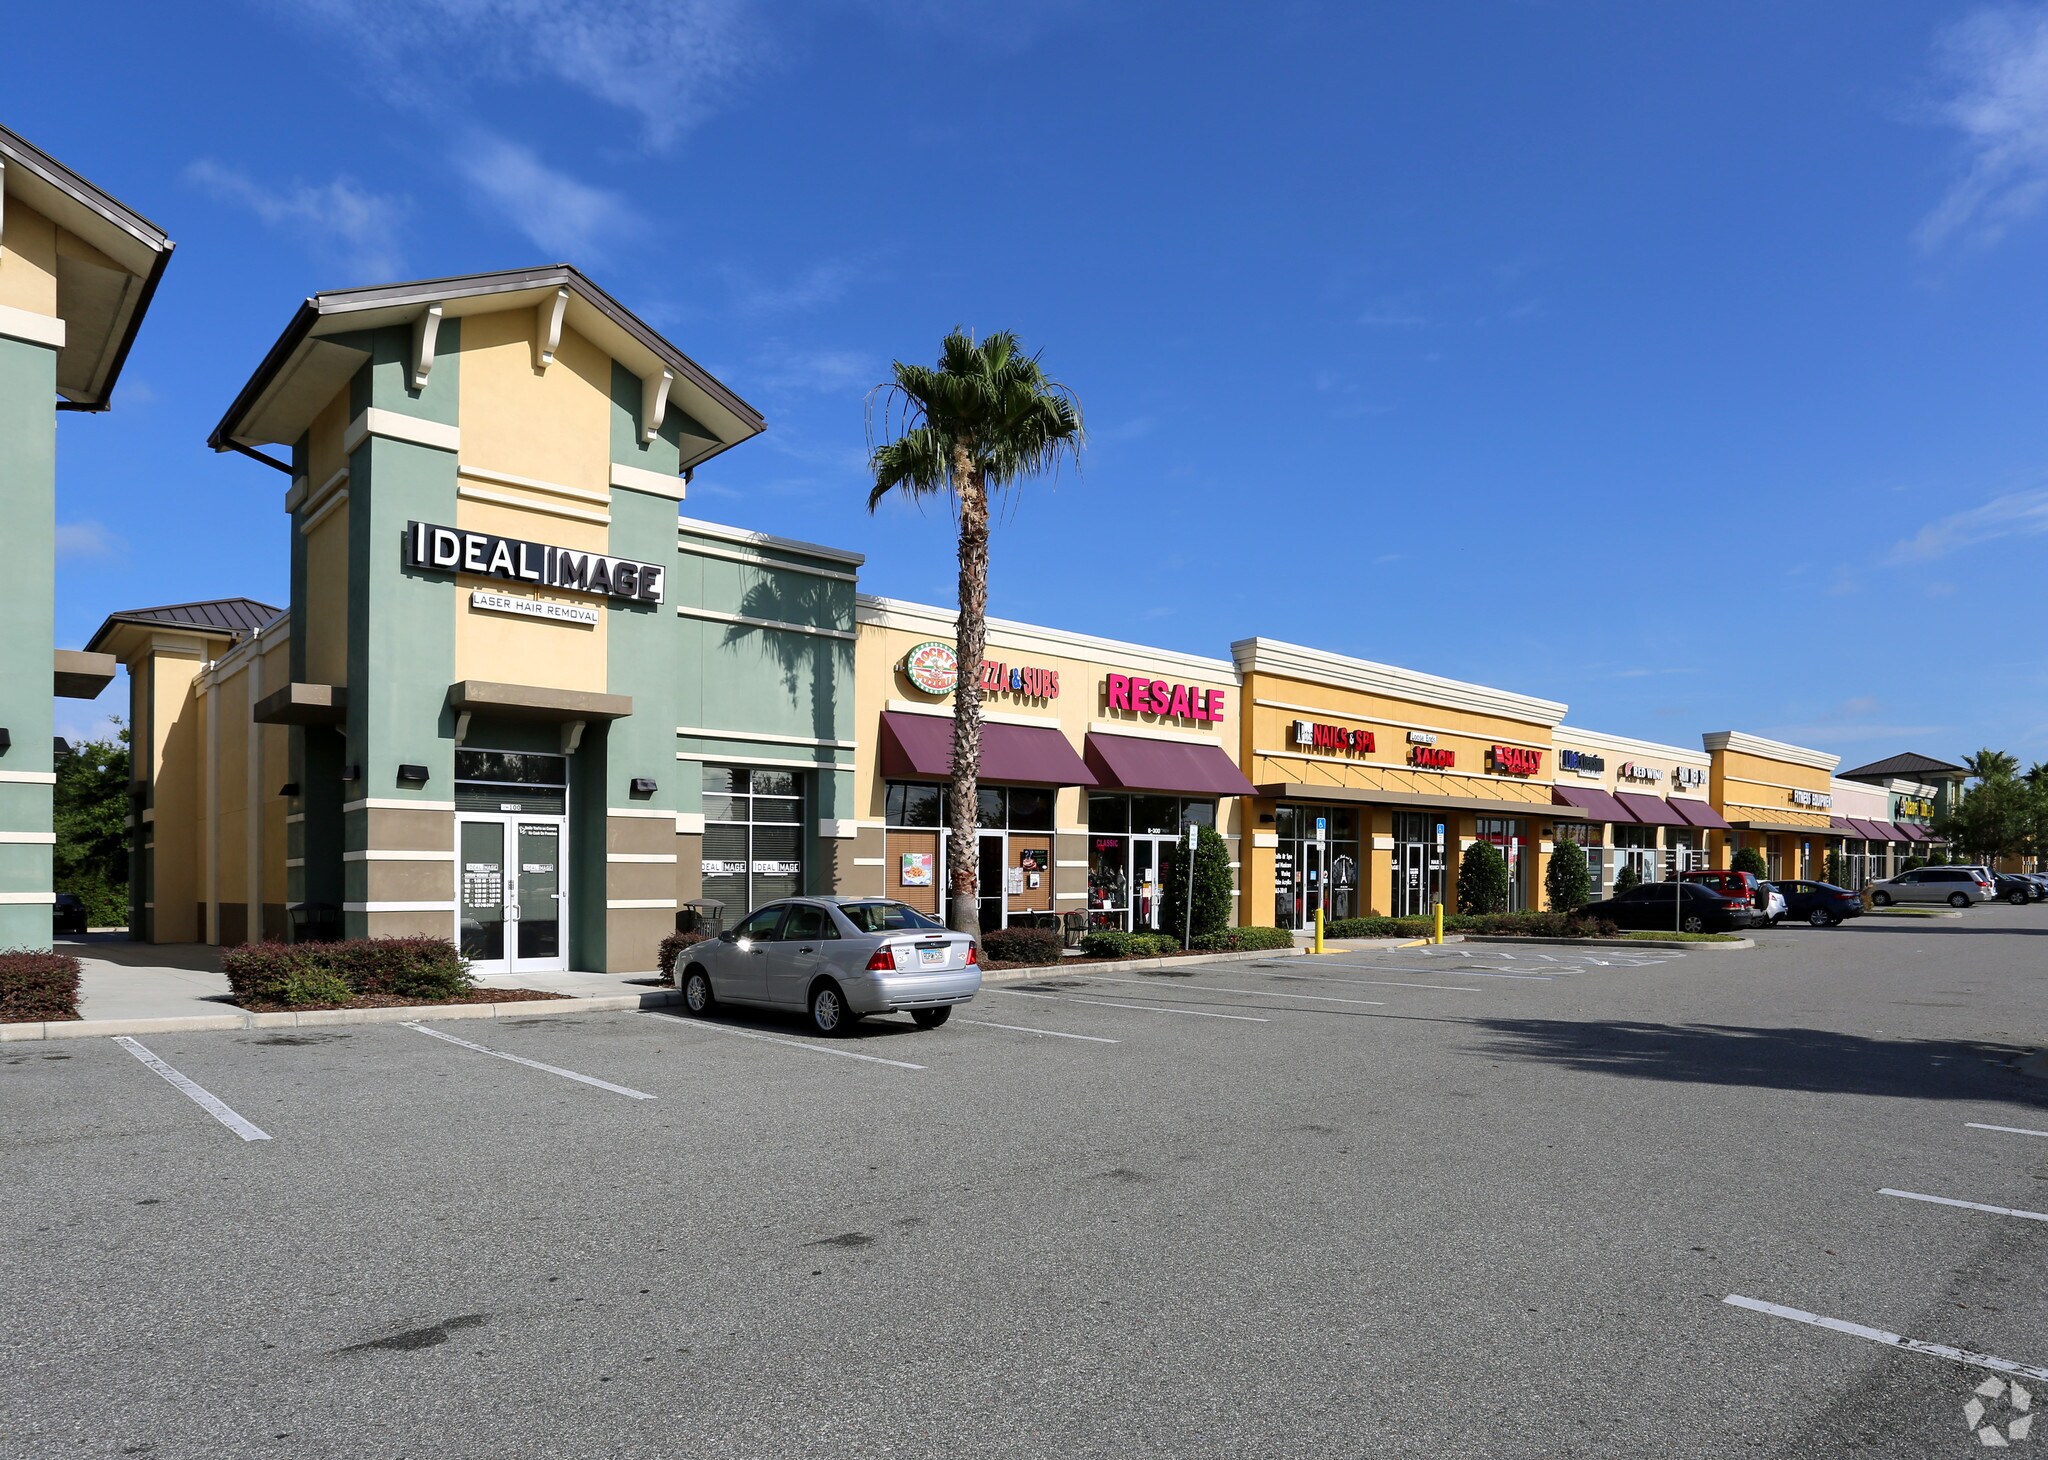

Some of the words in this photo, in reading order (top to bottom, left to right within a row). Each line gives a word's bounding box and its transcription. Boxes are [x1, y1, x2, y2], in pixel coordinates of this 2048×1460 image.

[416, 523, 540, 581] IDEAL
[547, 551, 662, 600] IMAGE
[473, 596, 511, 610] LASER
[516, 602, 543, 614] HAIR
[547, 606, 598, 622] REMOVAL
[1012, 667, 1021, 690] &
[1023, 667, 1059, 699] SUBS
[1108, 673, 1225, 722] RESALE
[1313, 723, 1348, 750] NAILS
[1349, 733, 1355, 745] &
[1354, 729, 1376, 753] SPA
[1415, 746, 1455, 767] SALON
[1503, 747, 1542, 770] SALLY
[1632, 766, 1647, 778] RED
[702, 863, 720, 871] DEAL
[754, 862, 776, 871] IDEAL
[777, 861, 800, 872] IMAGE
